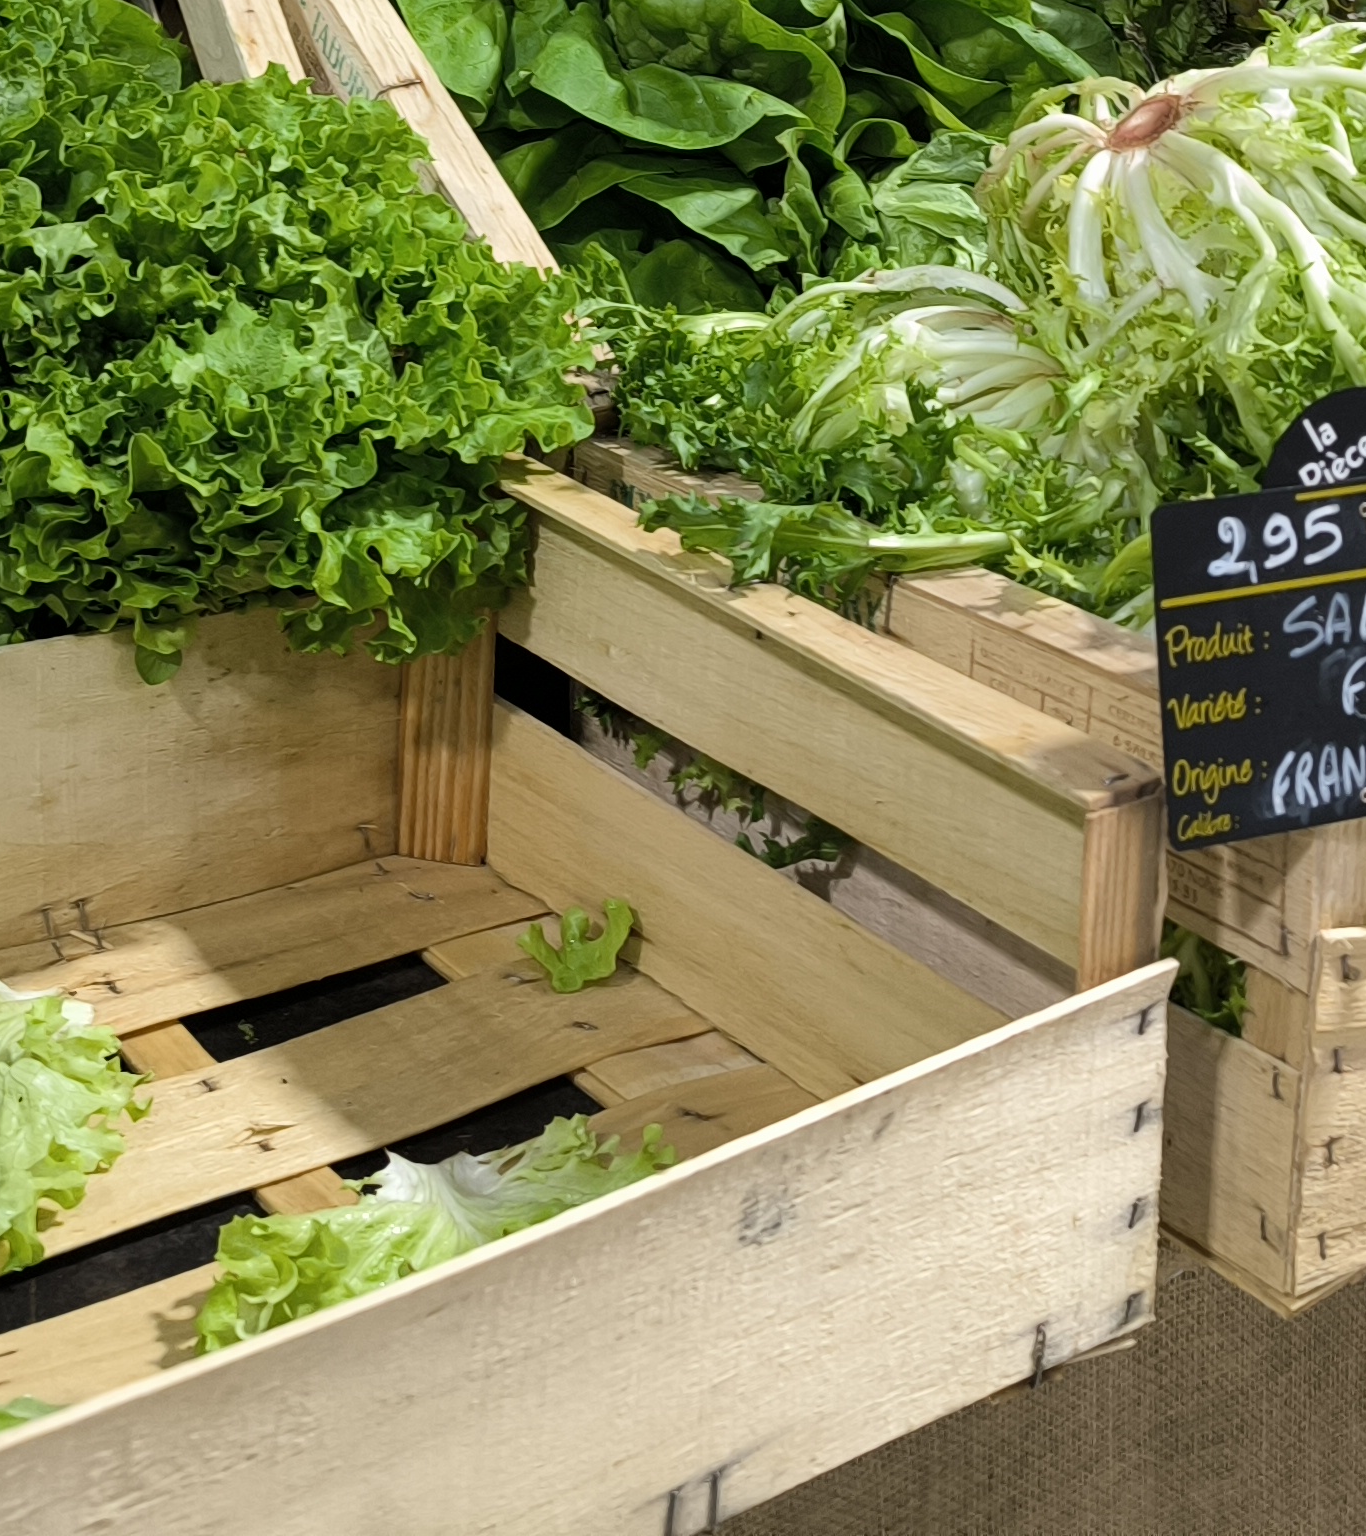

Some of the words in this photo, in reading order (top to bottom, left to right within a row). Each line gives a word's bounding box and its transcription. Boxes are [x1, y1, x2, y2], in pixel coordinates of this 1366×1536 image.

[1303, 419, 1337, 452] la
[1208, 504, 1342, 583] 2,95
[1165, 625, 1255, 667] Produit
[1172, 759, 1254, 803] Origine
